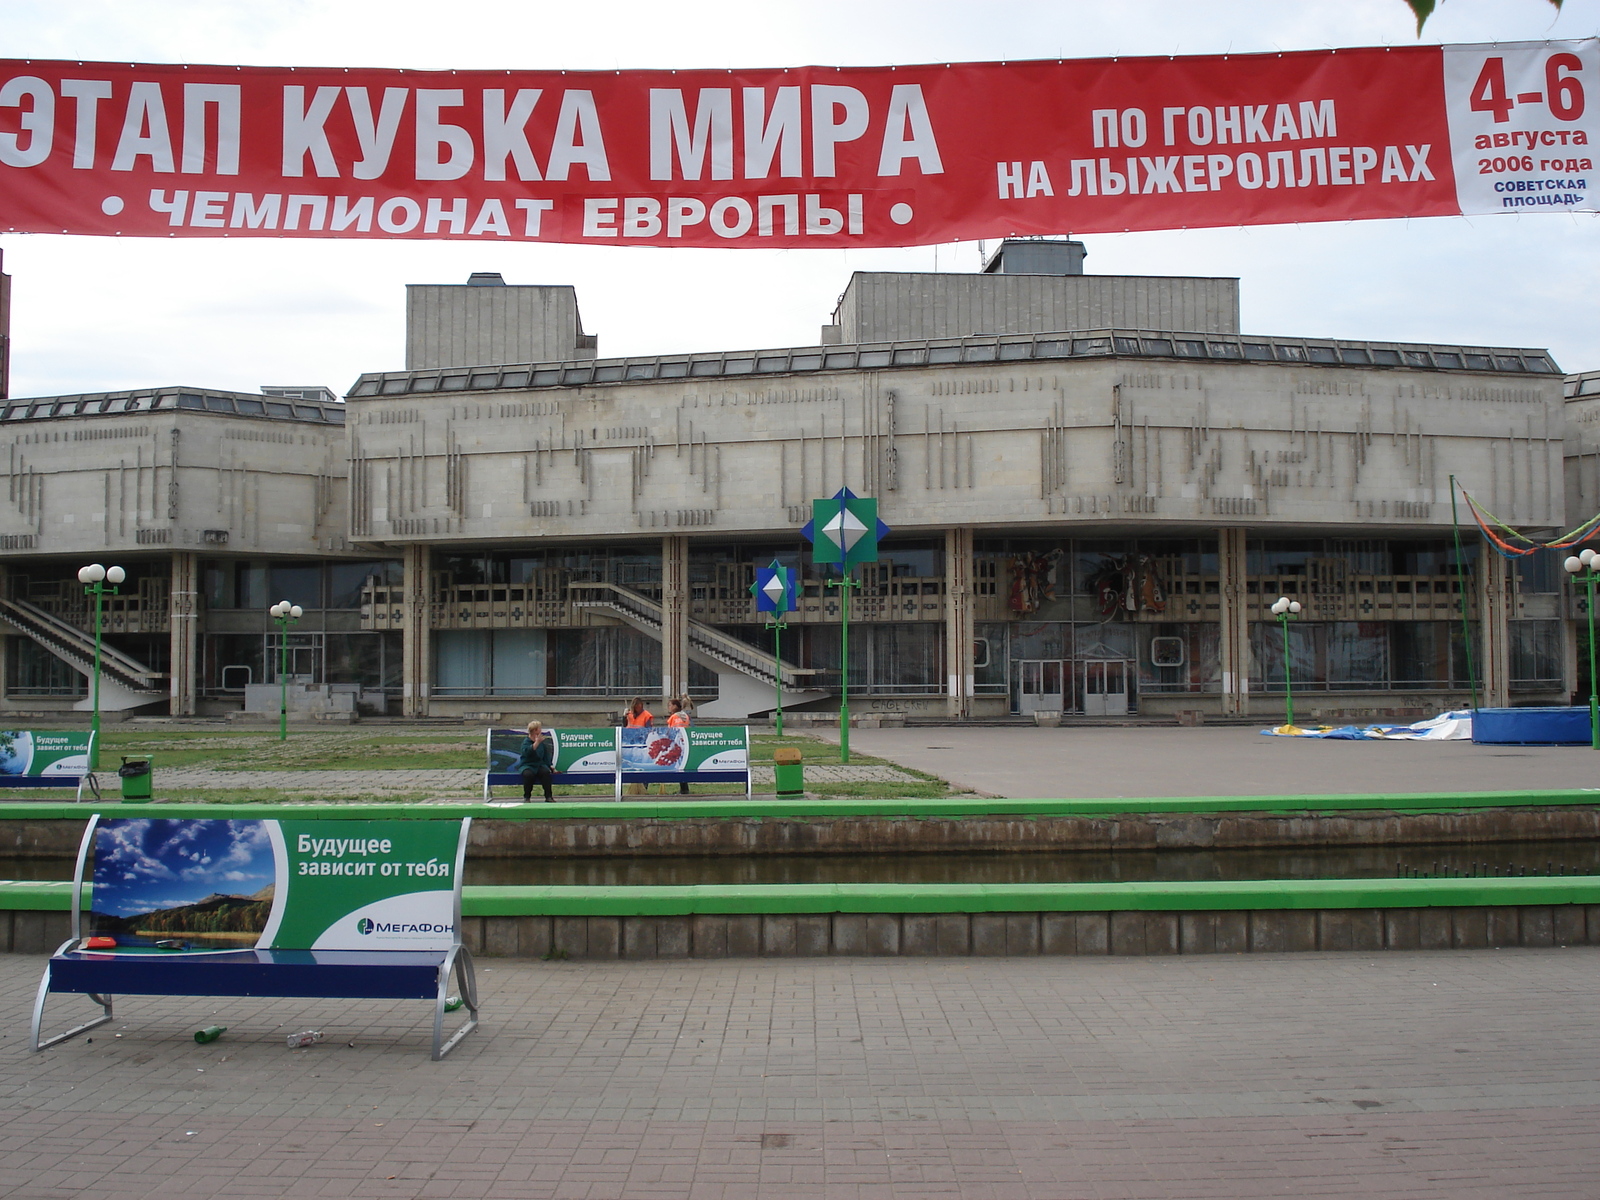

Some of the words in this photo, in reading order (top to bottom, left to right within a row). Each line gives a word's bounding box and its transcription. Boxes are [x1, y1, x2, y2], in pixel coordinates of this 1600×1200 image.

[1470, 53, 1585, 123] 4-6
[0, 75, 242, 176] ЭТАП
[281, 84, 611, 182] КУБКА
[650, 83, 945, 181] МИРА
[1092, 107, 1147, 148] ПО
[1162, 99, 1337, 147] ГОНКАМ
[1474, 130, 1588, 150] августа
[997, 160, 1055, 200] НА
[1067, 143, 1436, 197] ЛЫЖЕРОЛЛЕРАХ
[1478, 156, 1534, 174] 2006
[1540, 157, 1593, 173] года
[1494, 179, 1587, 193] СОВЕТСКАЯ
[1502, 193, 1585, 208] ПЛОЩАДЬ
[149, 188, 554, 238] ЧЕМПИОНАТ
[582, 193, 864, 238] ЕВРОПЫ
[36, 736, 69, 744] Будущее
[560, 733, 594, 741] Будущее
[690, 731, 723, 740] Будущее
[728, 738, 743, 746] тебя
[297, 834, 392, 858] Будущее
[298, 861, 376, 876] зависит
[380, 863, 402, 877] от
[406, 858, 450, 877] тебя
